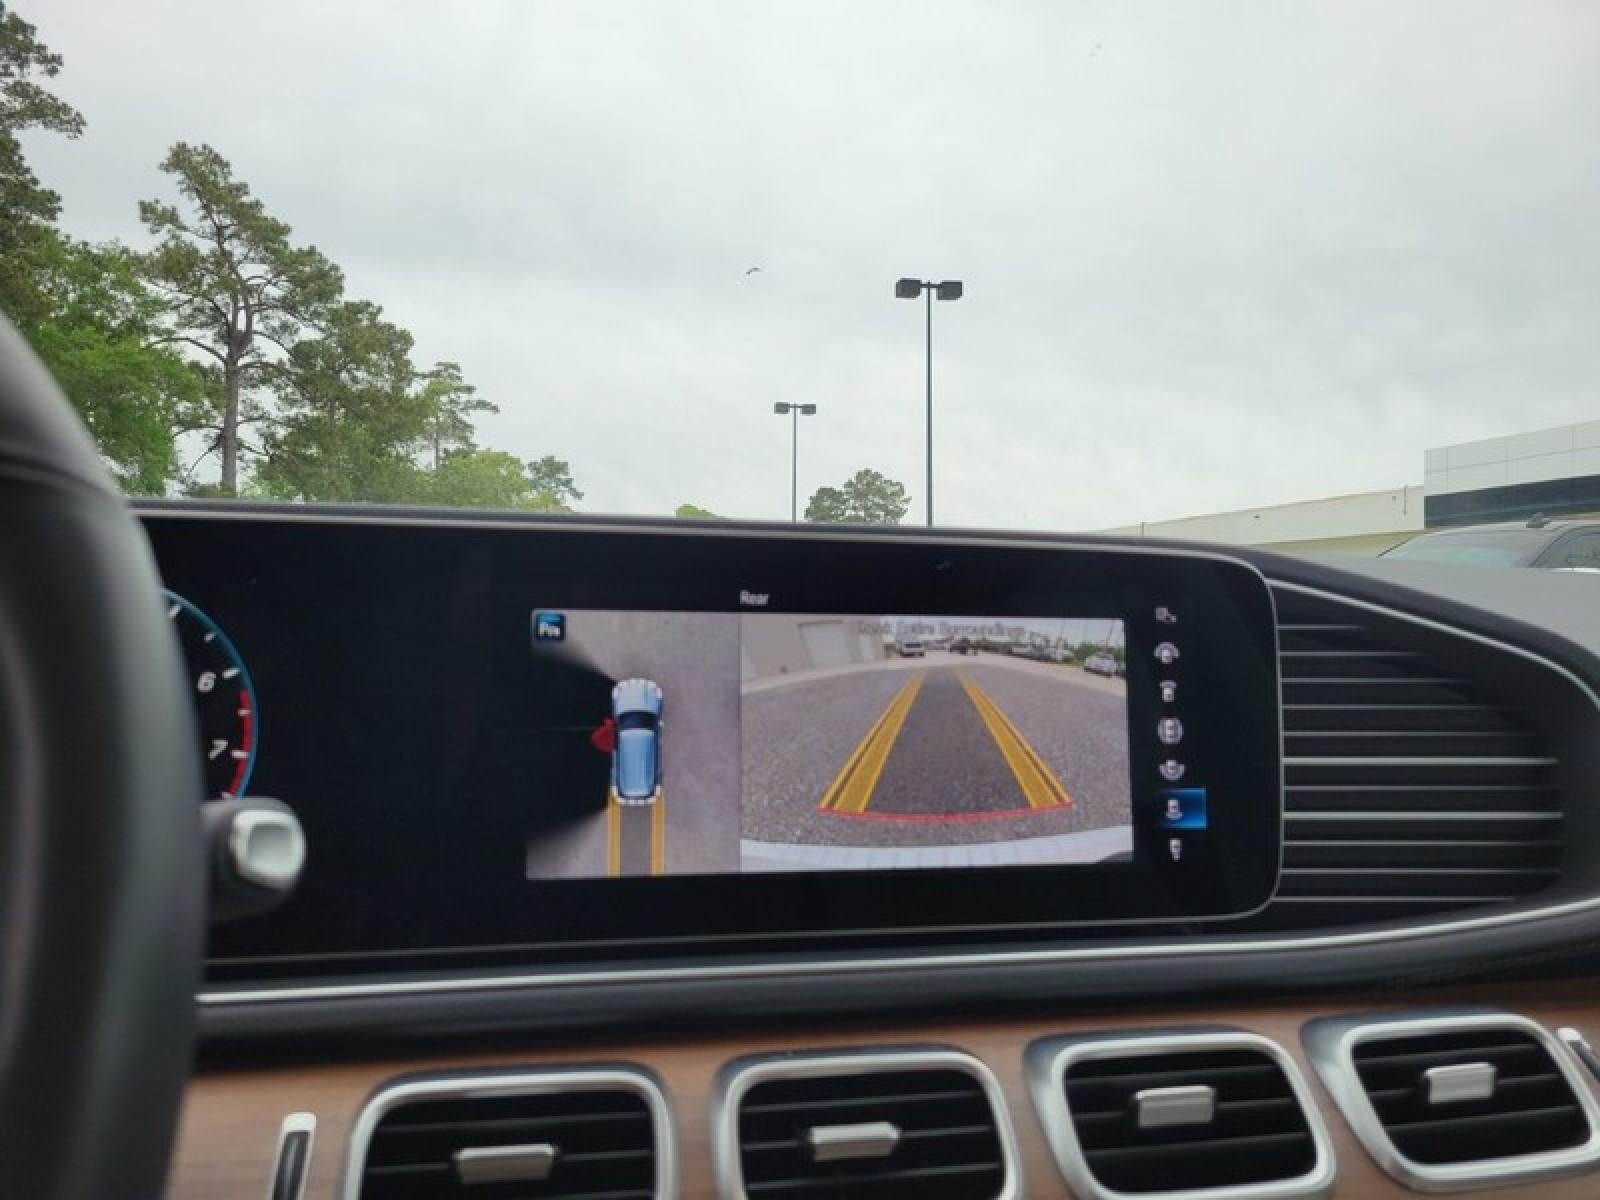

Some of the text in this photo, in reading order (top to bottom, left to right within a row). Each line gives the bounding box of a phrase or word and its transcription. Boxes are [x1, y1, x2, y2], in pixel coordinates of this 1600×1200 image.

[740, 591, 769, 606] Rear
[197, 671, 217, 692] 6
[208, 739, 228, 760] 7
